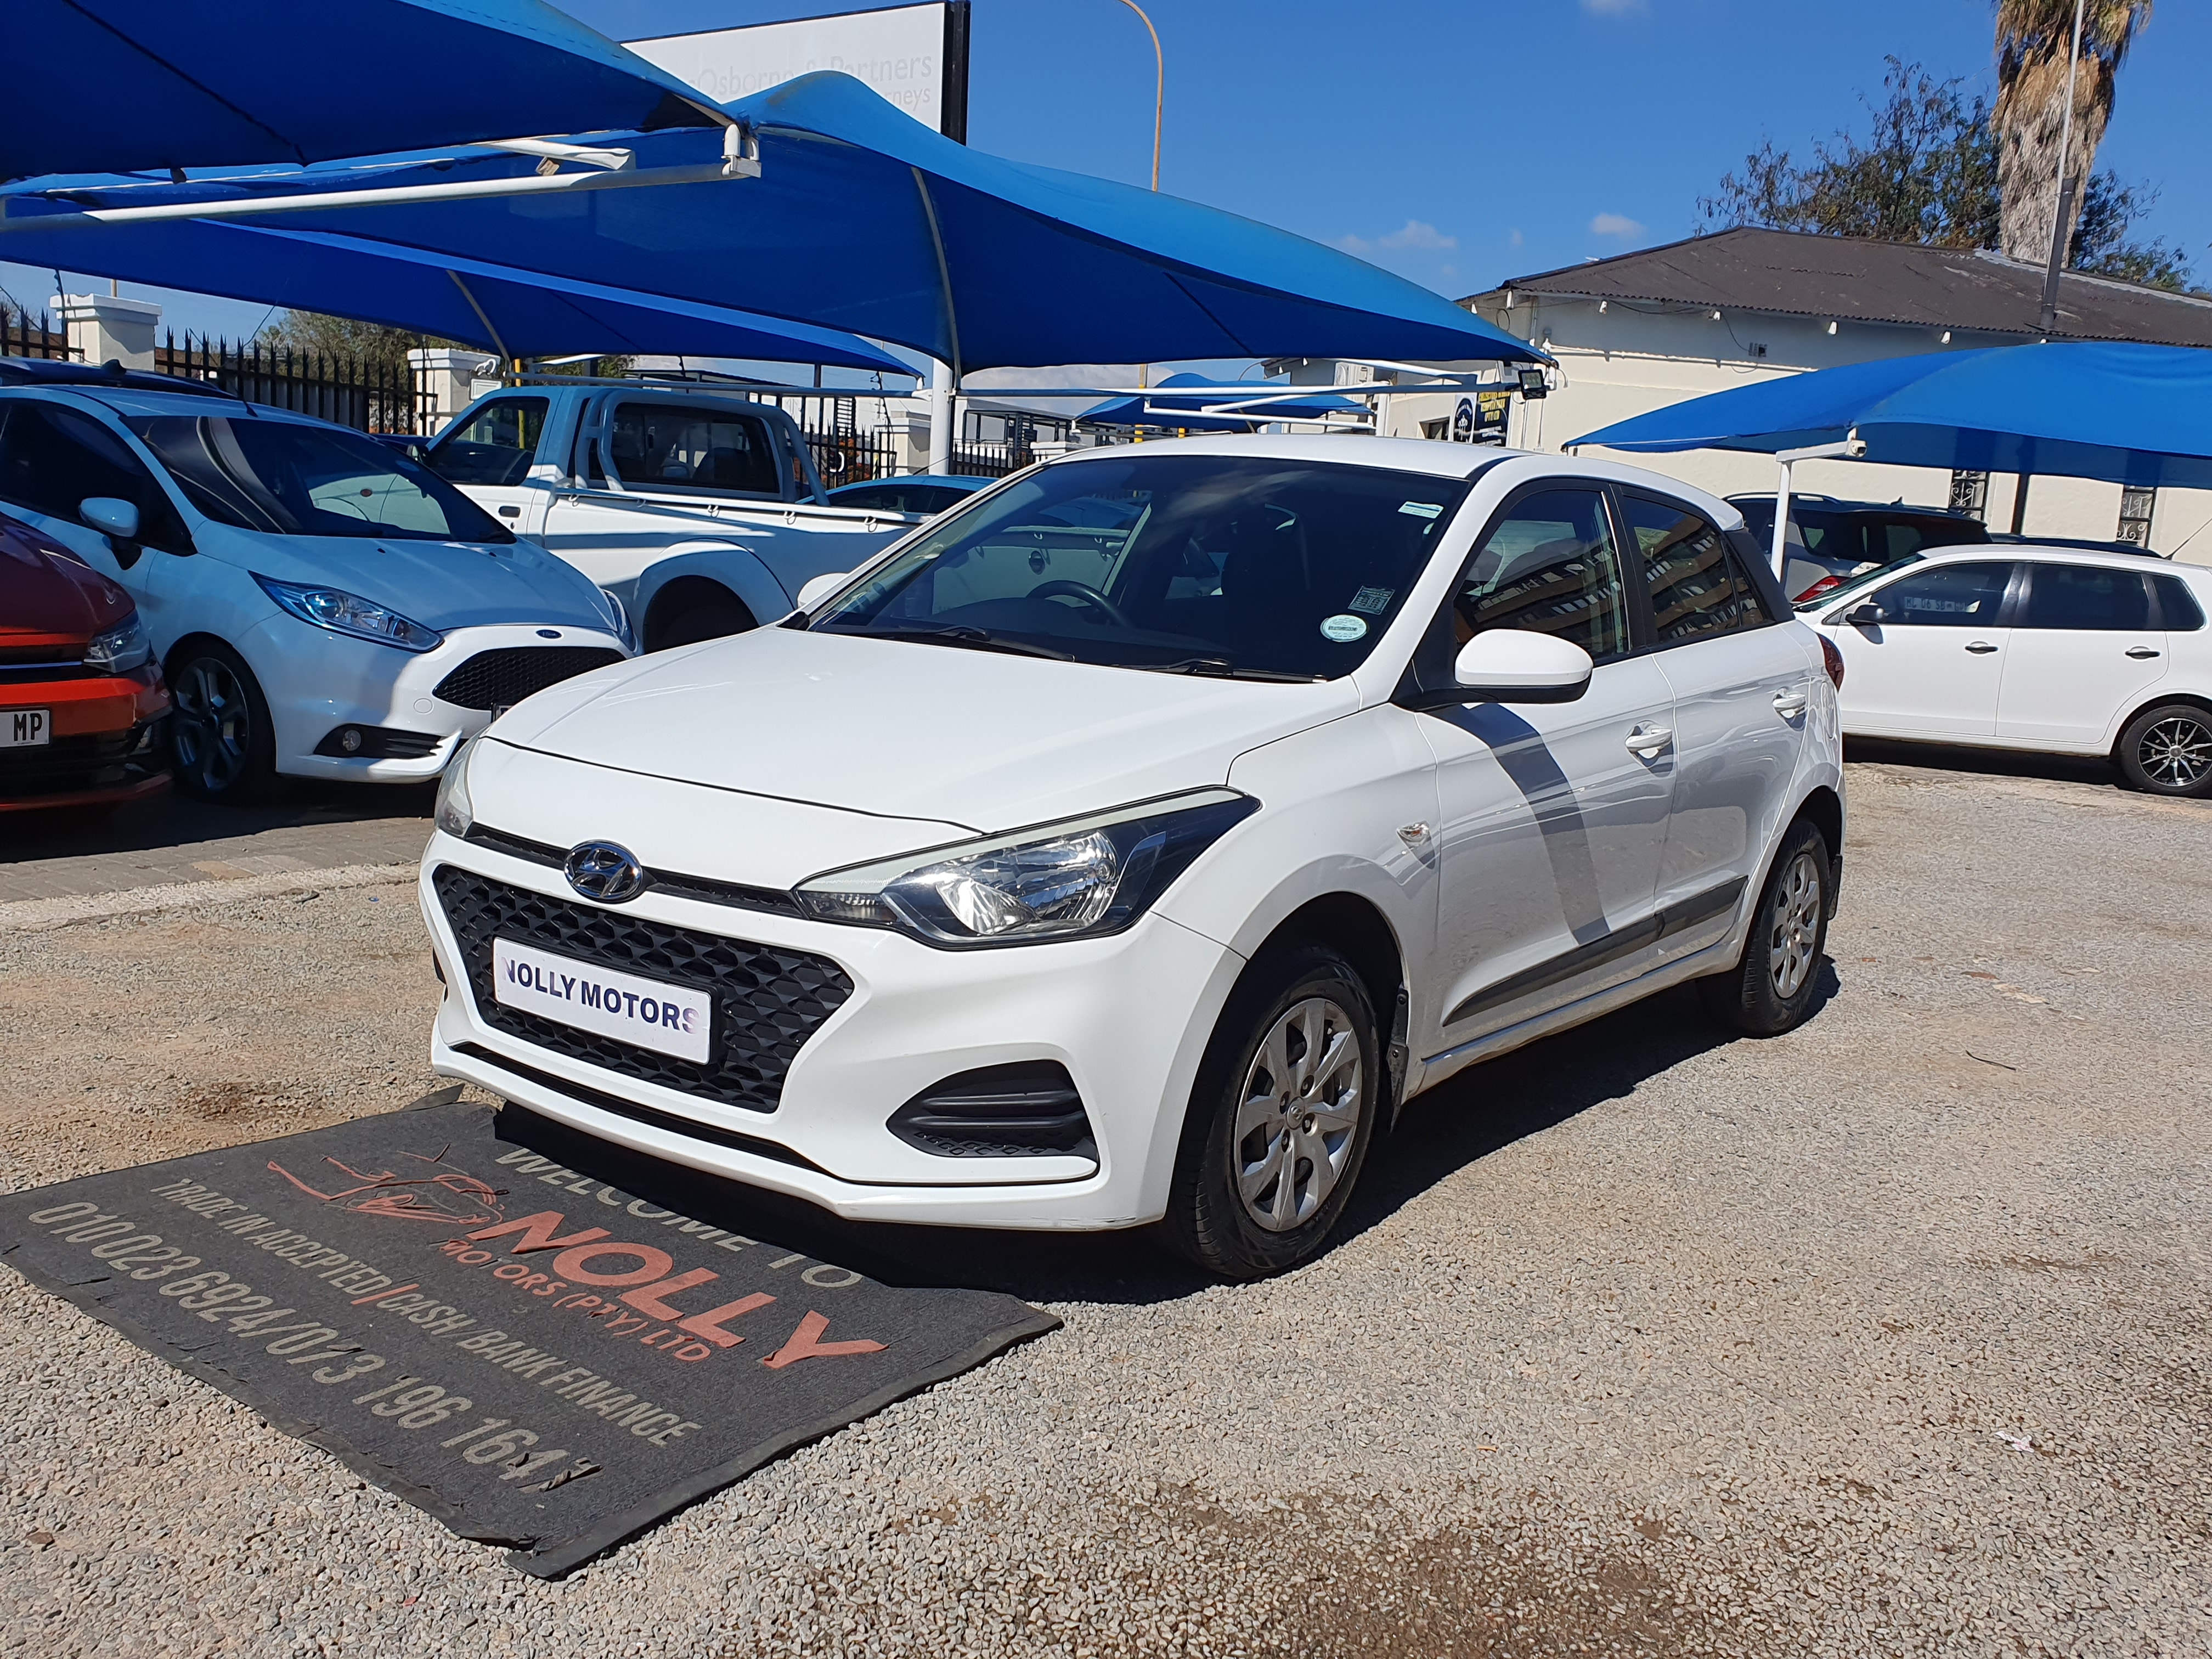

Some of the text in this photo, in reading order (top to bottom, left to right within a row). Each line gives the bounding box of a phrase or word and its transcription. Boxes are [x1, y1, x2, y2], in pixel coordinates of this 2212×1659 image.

[14, 713, 43, 741] MP
[501, 956, 700, 1035] NOLLY MOTORS
[29, 1202, 136, 1244] 010
[91, 1234, 201, 1281] 023
[353, 1374, 473, 1429] 196
[150, 1178, 249, 1219] TRADE
[219, 1214, 275, 1235] IN
[539, 1367, 703, 1447] FINANCE
[439, 1238, 711, 1362] MOTORS (PTY) LTD
[465, 1210, 889, 1369] NOLLY
